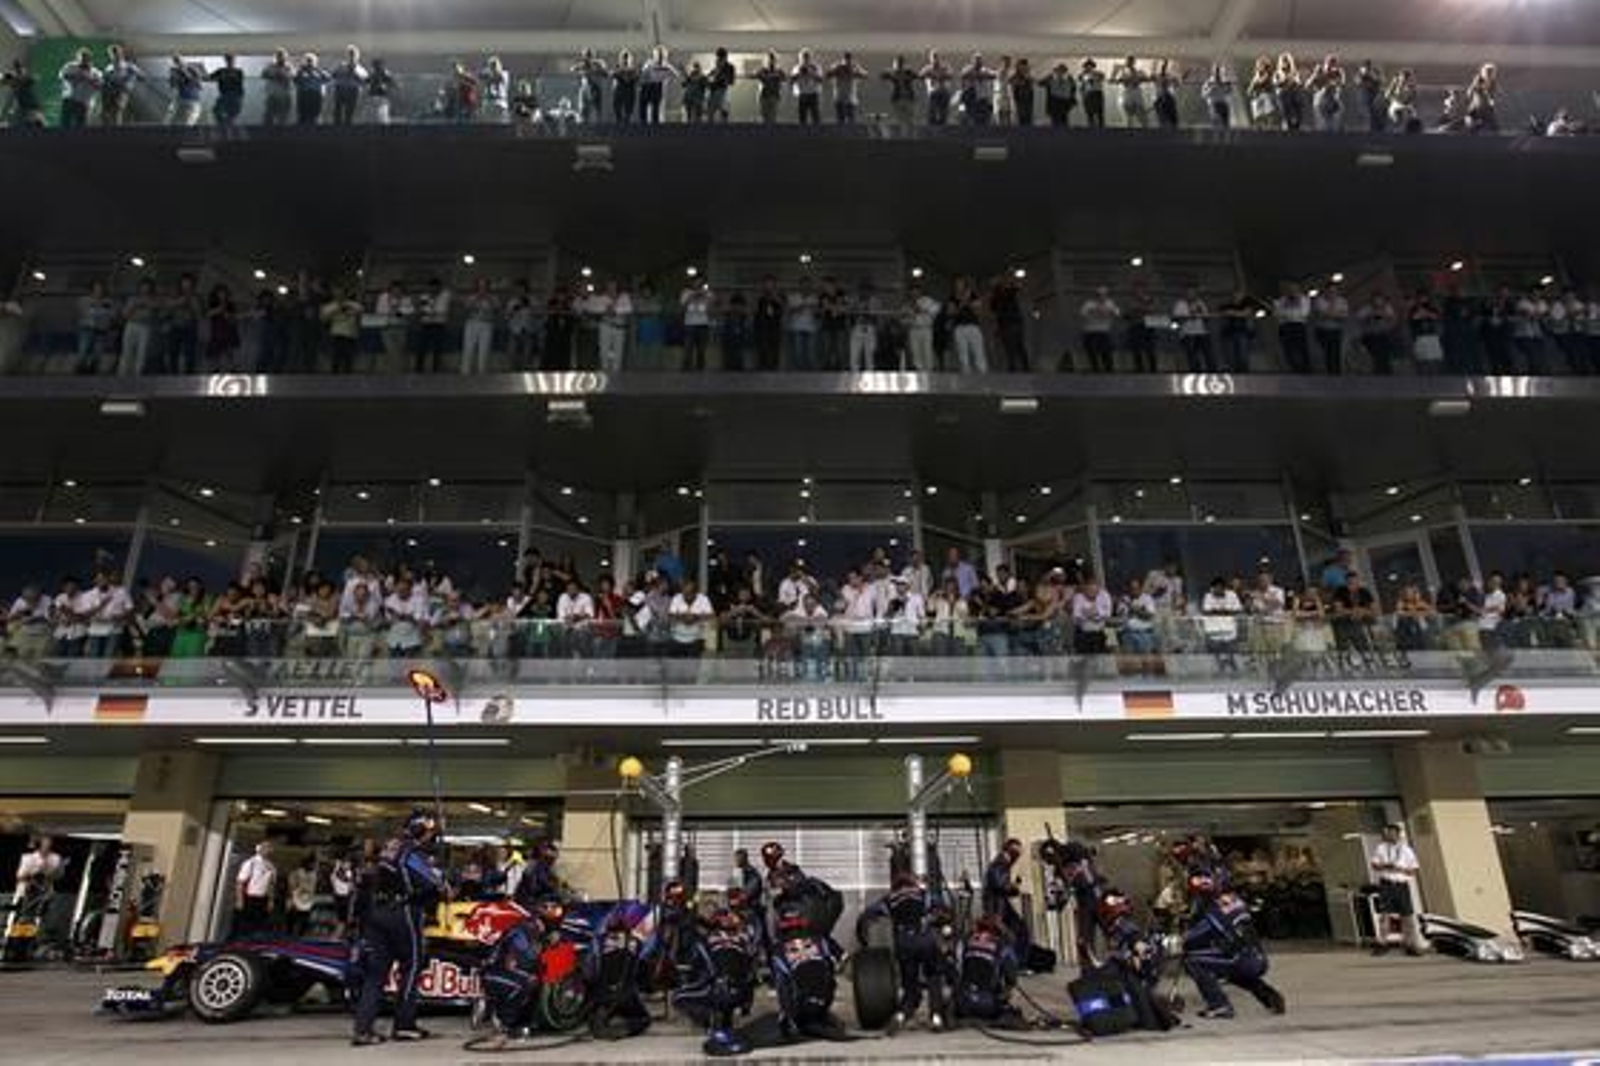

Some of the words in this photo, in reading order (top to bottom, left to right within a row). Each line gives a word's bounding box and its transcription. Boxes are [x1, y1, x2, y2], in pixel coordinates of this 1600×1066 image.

[267, 696, 363, 717] VETTEL
[758, 698, 811, 720] RED
[818, 696, 884, 720] BULL
[1228, 695, 1249, 714] M
[1253, 690, 1427, 714] SCHUMACHER
